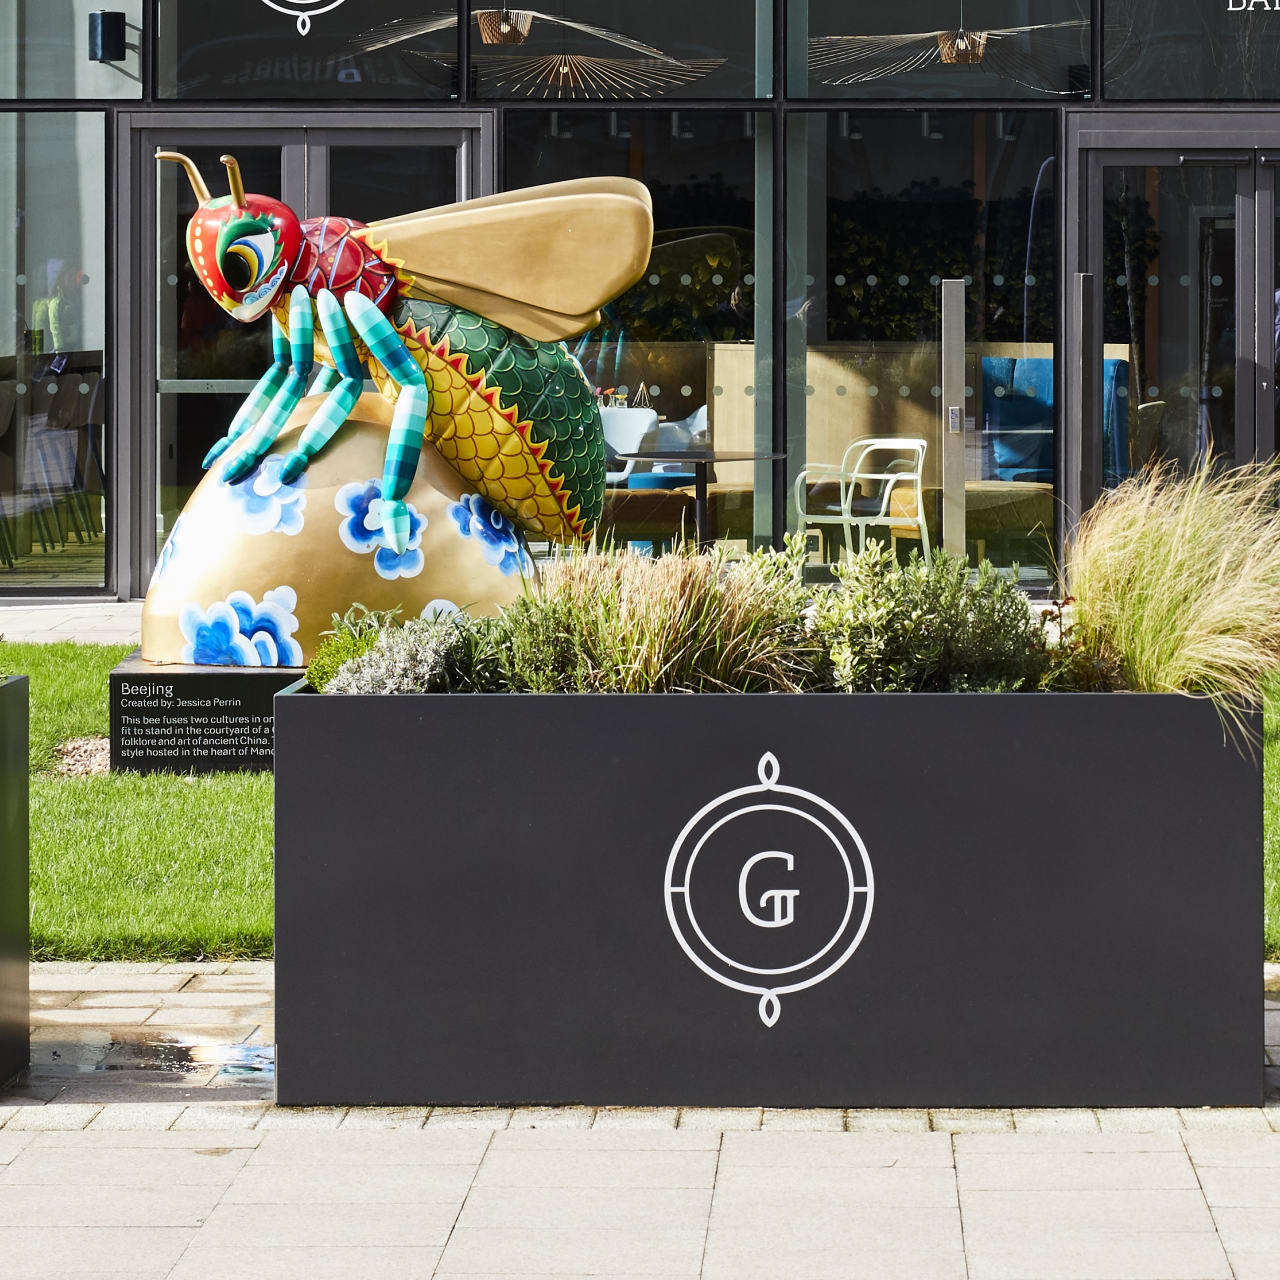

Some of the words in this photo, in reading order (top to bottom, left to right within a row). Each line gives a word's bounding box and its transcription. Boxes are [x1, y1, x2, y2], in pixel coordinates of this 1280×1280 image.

[122, 683, 173, 697] Beejing
[121, 699, 158, 707] Created
[161, 699, 174, 708] by:
[177, 698, 211, 706] Jessica
[214, 698, 241, 706] Perrin
[121, 716, 140, 724] This
[143, 716, 160, 724] bee
[163, 716, 188, 724] fuses
[191, 716, 208, 724] two
[211, 715, 249, 723] cultures
[252, 715, 260, 723] in
[121, 727, 131, 735] fit
[134, 727, 143, 735] to
[146, 727, 172, 735] stand
[186, 726, 201, 734] the
[204, 726, 249, 736] courtyard
[252, 725, 262, 733] of
[122, 737, 156, 745] folklore
[158, 737, 175, 745] and
[178, 737, 190, 745] art
[192, 736, 202, 745] of
[203, 737, 238, 745] ancient
[240, 736, 270, 744] China.
[121, 748, 144, 758] style
[147, 748, 178, 756] hosted
[193, 748, 208, 756] the
[239, 747, 248, 755] of
